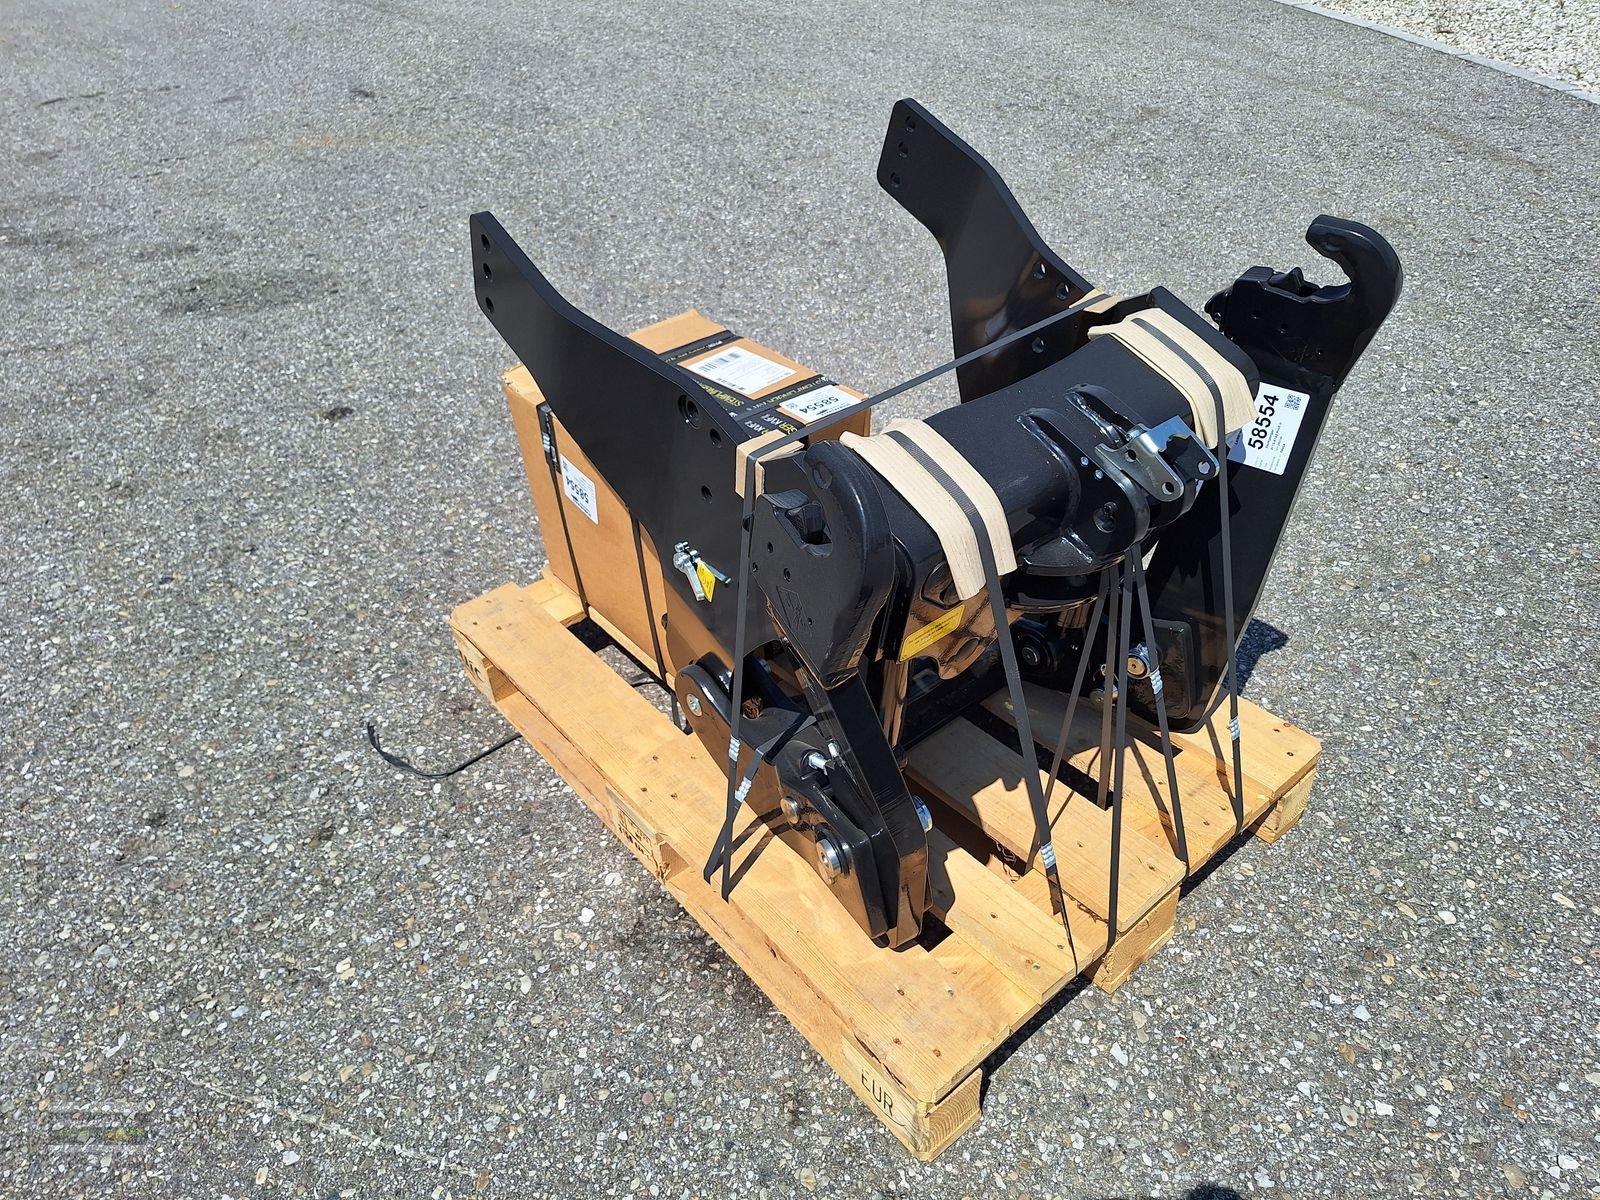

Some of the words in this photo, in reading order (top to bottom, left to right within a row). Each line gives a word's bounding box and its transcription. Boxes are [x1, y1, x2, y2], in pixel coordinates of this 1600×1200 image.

[800, 396, 839, 414] 58554
[1248, 394, 1280, 450] 58554
[565, 475, 590, 504] 58554
[861, 1068, 893, 1117] EUR
